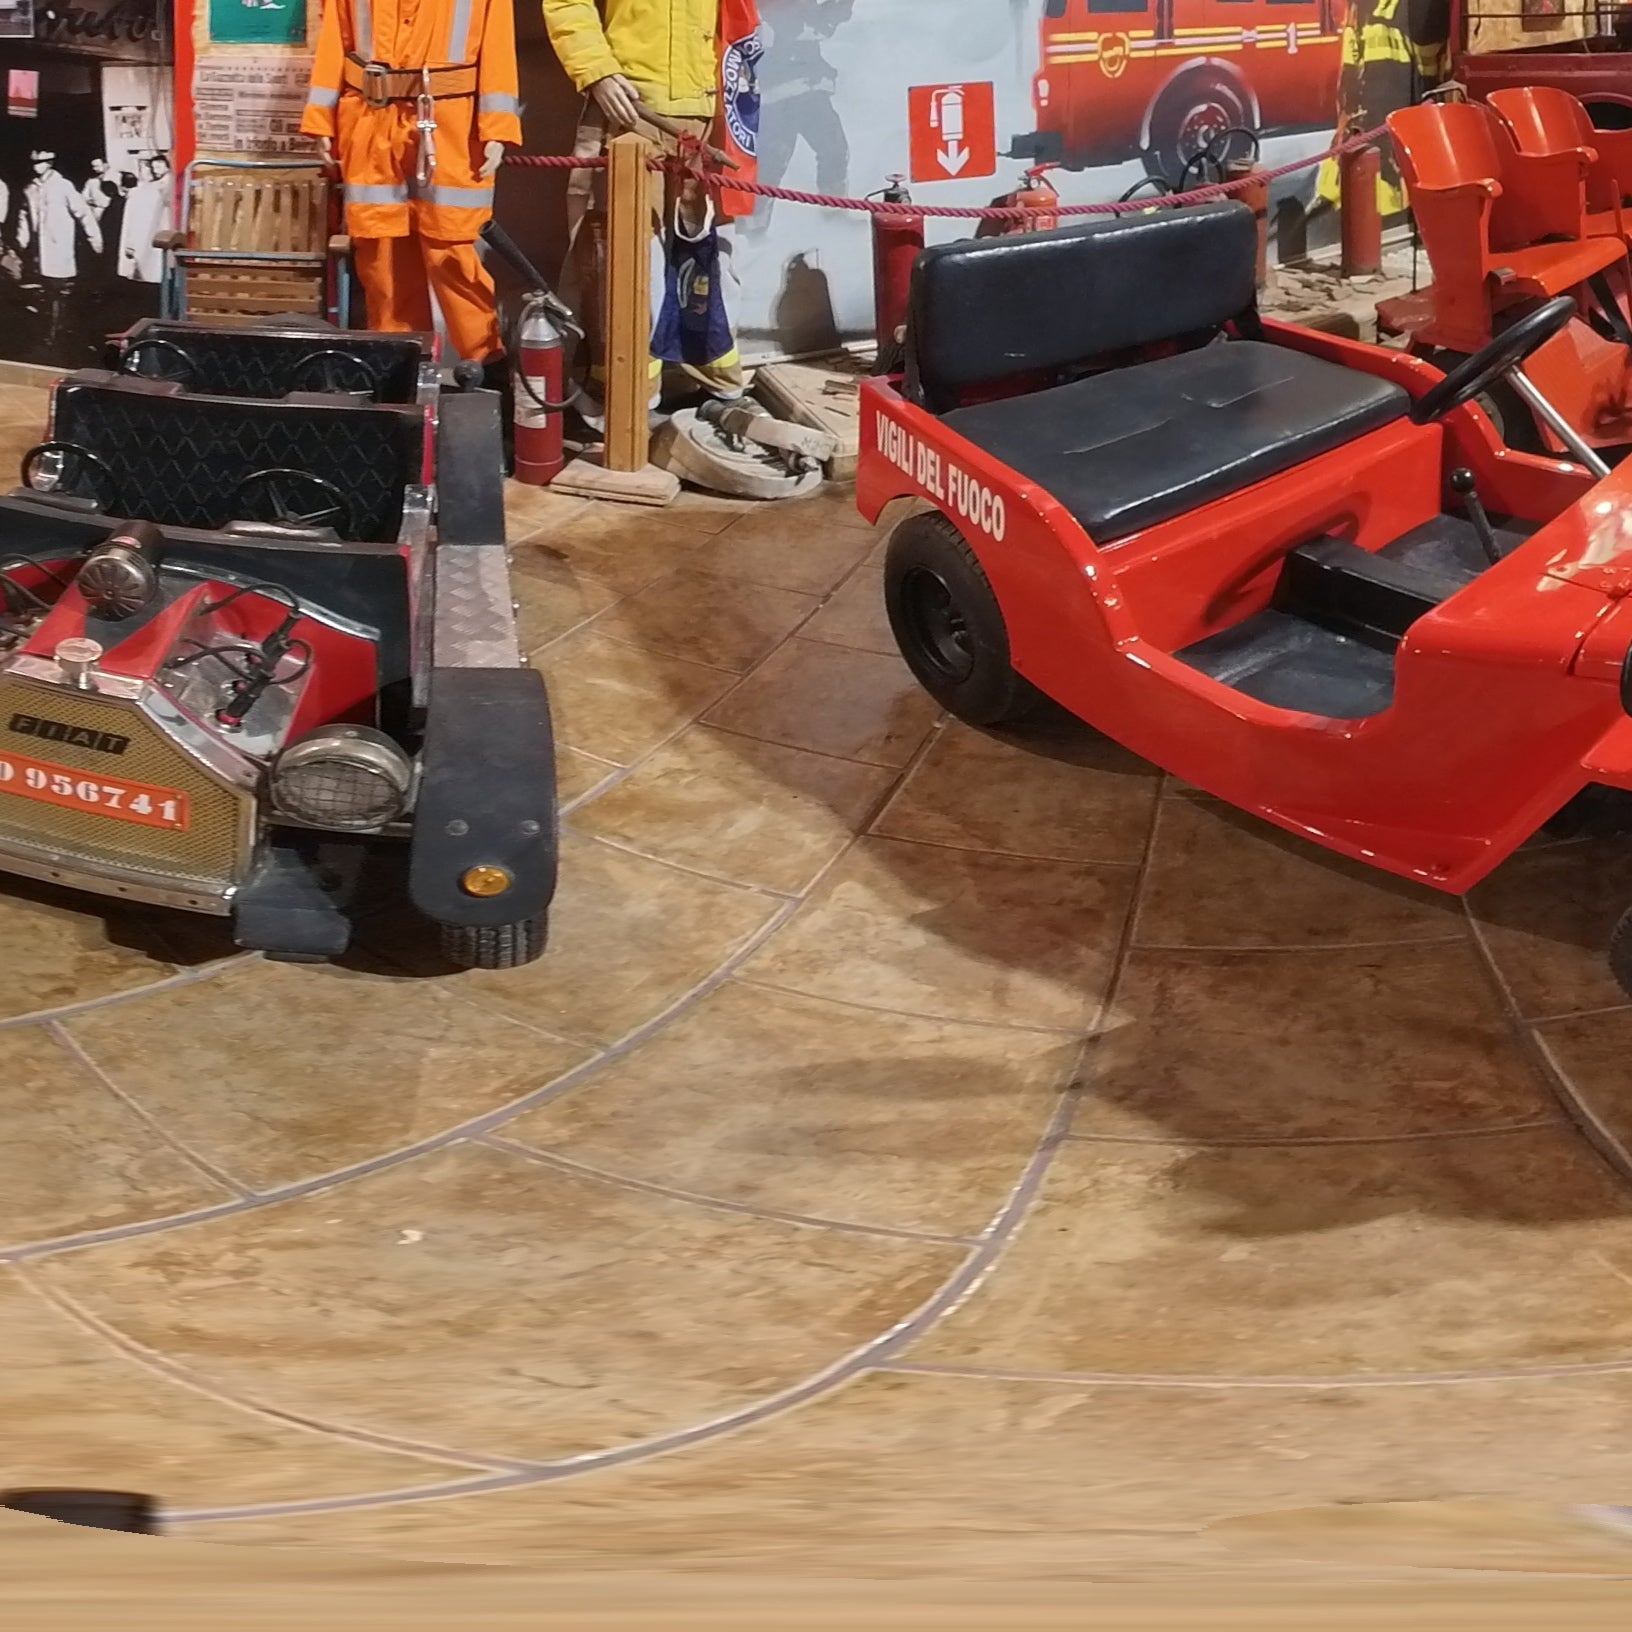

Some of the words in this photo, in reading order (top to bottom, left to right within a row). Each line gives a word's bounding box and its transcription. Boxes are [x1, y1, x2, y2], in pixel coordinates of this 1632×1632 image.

[876, 410, 913, 477] VIGILI
[917, 441, 945, 501] DEL
[948, 463, 1005, 542] FUOCO
[17, 718, 124, 751] FIAT
[24, 767, 177, 821] 956741
